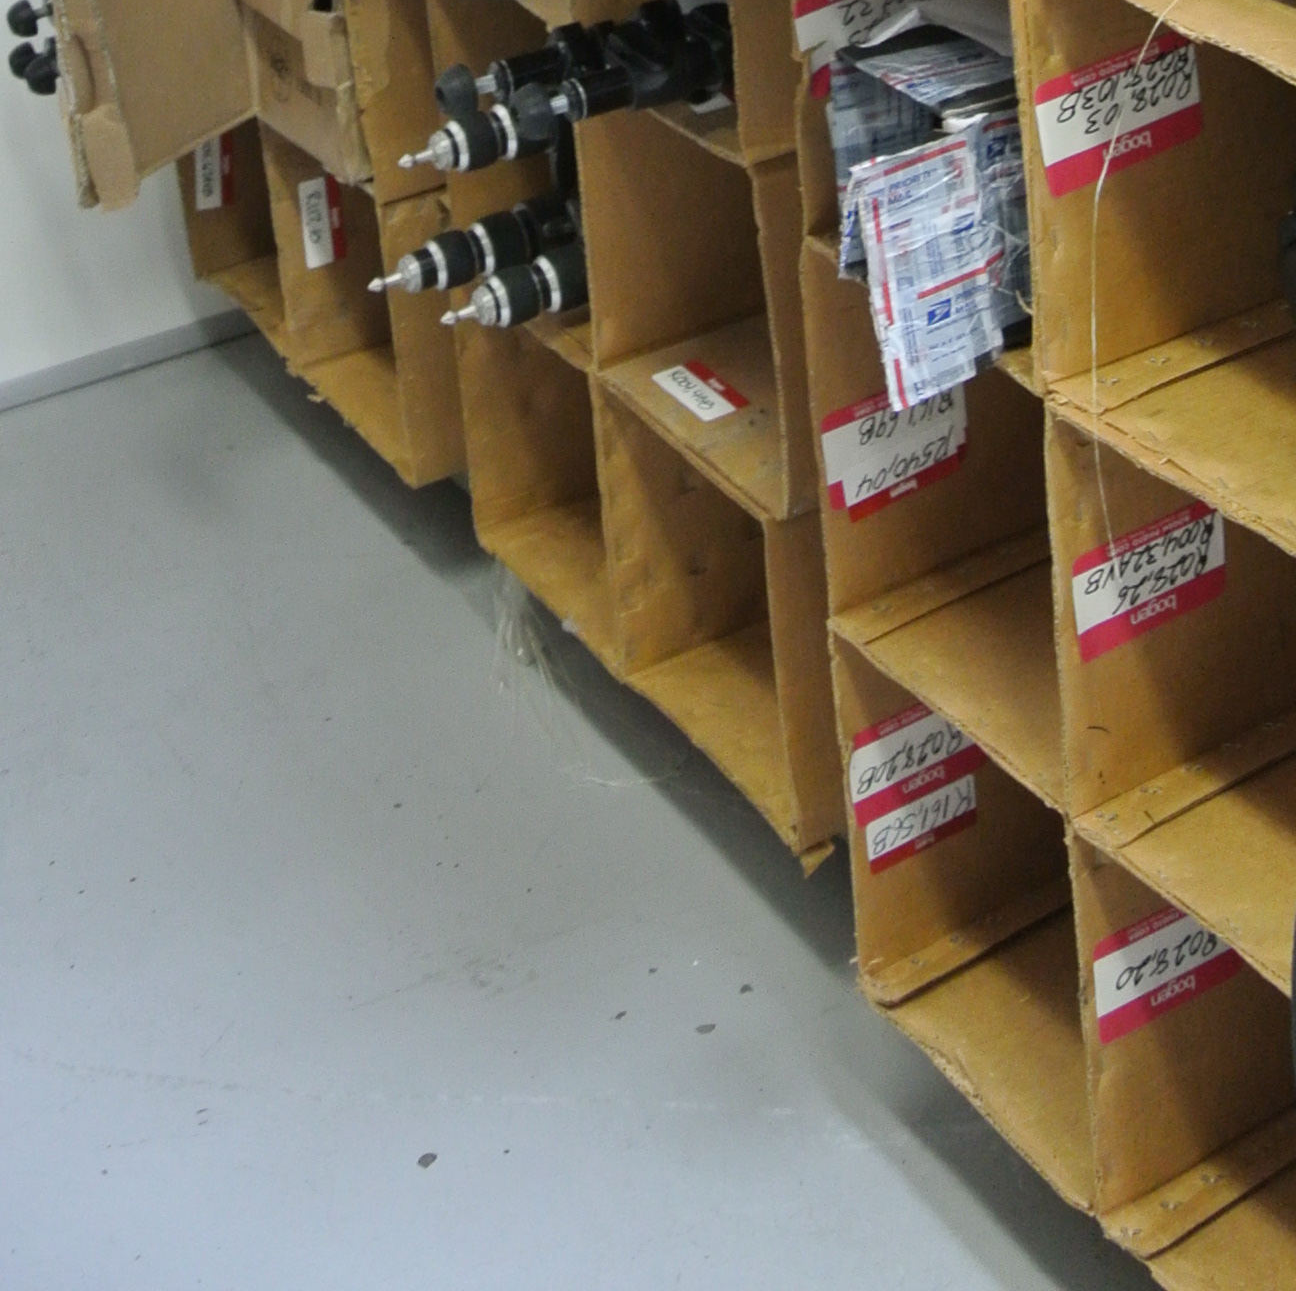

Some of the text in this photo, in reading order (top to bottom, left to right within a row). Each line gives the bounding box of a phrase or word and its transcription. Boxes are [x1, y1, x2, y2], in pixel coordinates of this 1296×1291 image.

[1130, 593, 1177, 627] bogen
[902, 764, 946, 794] bogen
[1150, 974, 1196, 1007] bogen
